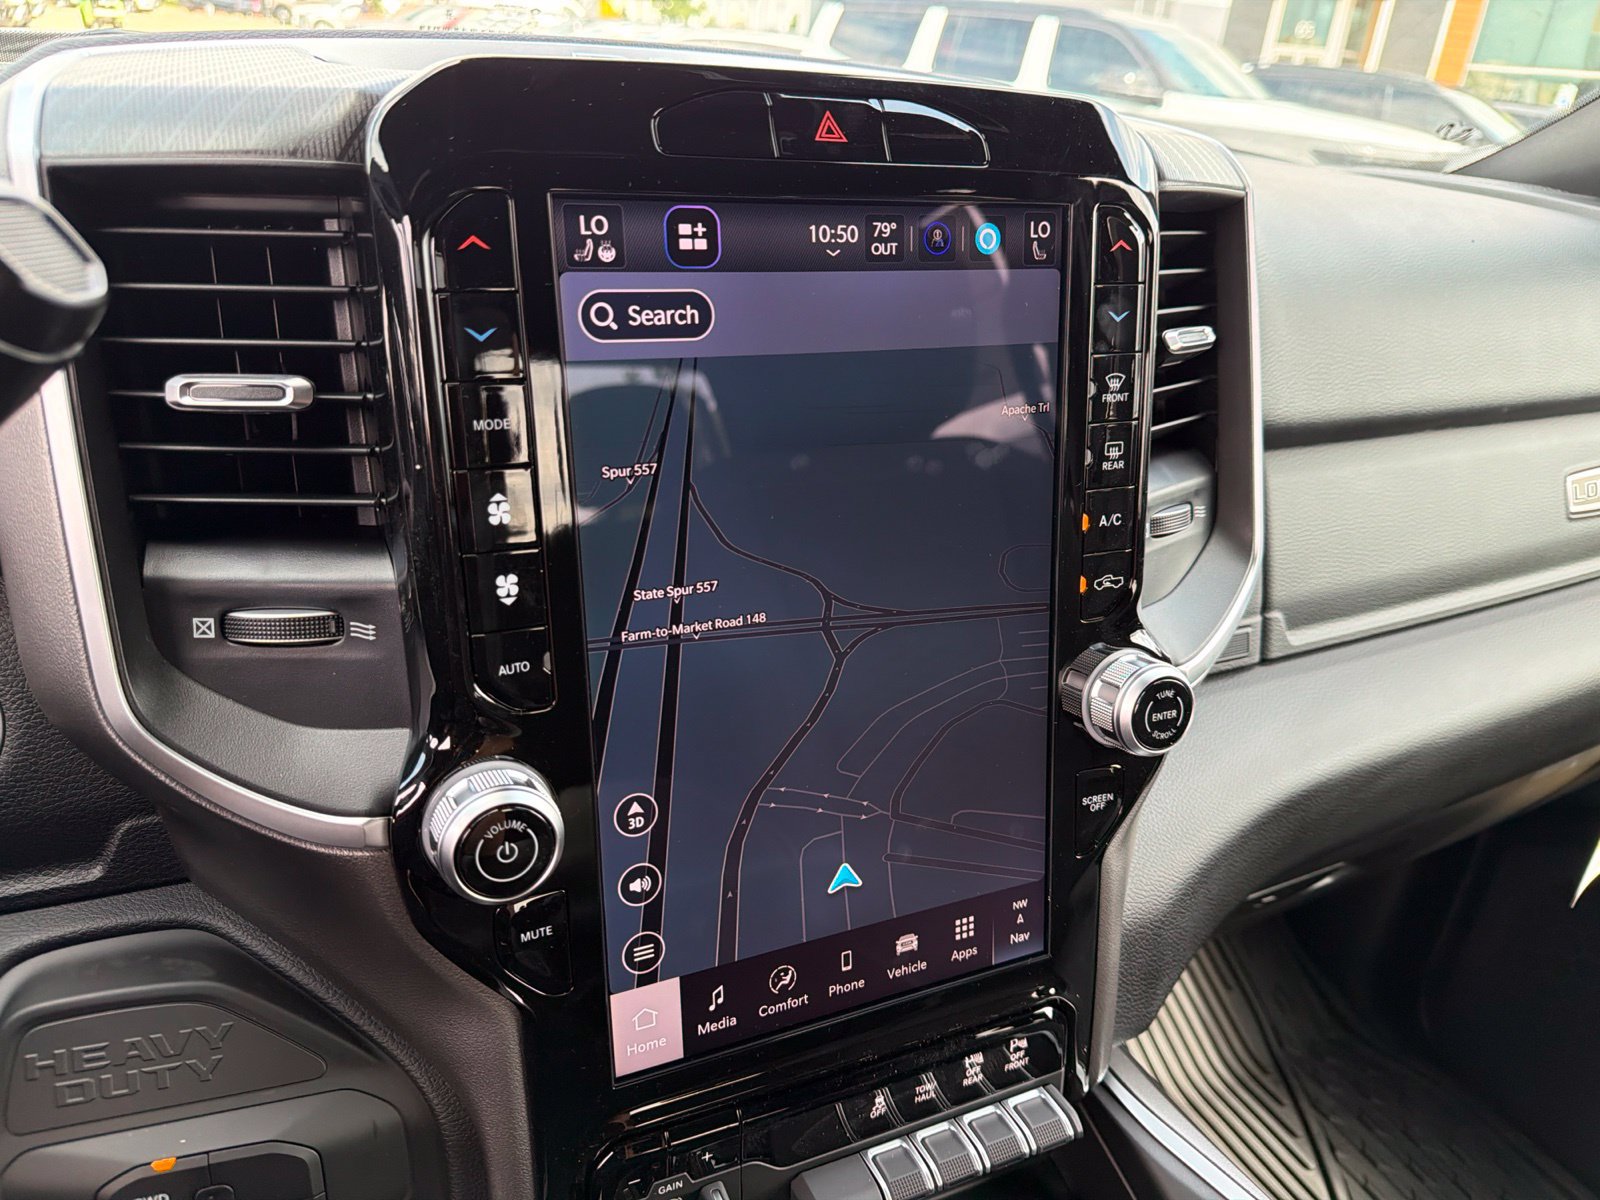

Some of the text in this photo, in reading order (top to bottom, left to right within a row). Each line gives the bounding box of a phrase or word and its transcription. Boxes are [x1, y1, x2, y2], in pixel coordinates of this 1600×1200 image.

[579, 214, 609, 235] LO
[872, 222, 897, 238] 79°
[1029, 220, 1051, 239] LO
[809, 224, 859, 243] 10:50
[870, 242, 898, 255] OUT
[627, 305, 700, 326] Search
[1101, 392, 1129, 403] FRONT
[1001, 402, 1050, 418] Apache Trl
[473, 418, 512, 431] MODE
[601, 463, 658, 481] Spur 557
[1102, 460, 1124, 471] REAR
[1098, 513, 1122, 527] A/C
[633, 580, 719, 601] State Spur 557
[621, 612, 767, 642] Farm-to-Market Road 148
[498, 661, 530, 677] AUTO
[1155, 689, 1177, 700] TUNE
[1152, 710, 1177, 722] ENTER
[1152, 729, 1177, 740] SCROLL
[1082, 793, 1114, 807] SCREEN
[1089, 801, 1107, 812] OFF
[484, 819, 528, 840] VOLUME
[628, 816, 645, 830] 3D
[1012, 898, 1028, 911] NW
[520, 925, 553, 943] MUTE
[1010, 931, 1030, 945] Nav
[950, 944, 979, 963] Apps
[886, 959, 928, 980] Vehicle
[828, 976, 866, 998] Phone
[758, 993, 809, 1018] Comfort
[697, 1014, 738, 1037] Media
[24, 1020, 235, 1082] HEAVY
[626, 1034, 668, 1057] Home
[1010, 1050, 1025, 1061] OFF
[966, 1066, 981, 1077] OFF
[1005, 1057, 1029, 1071] FRONT
[54, 1053, 225, 1109] DUTY
[963, 1074, 983, 1086] REAR
[915, 1093, 936, 1103] HAUL
[870, 1108, 887, 1119] OFF
[657, 1180, 684, 1195] GAIN
